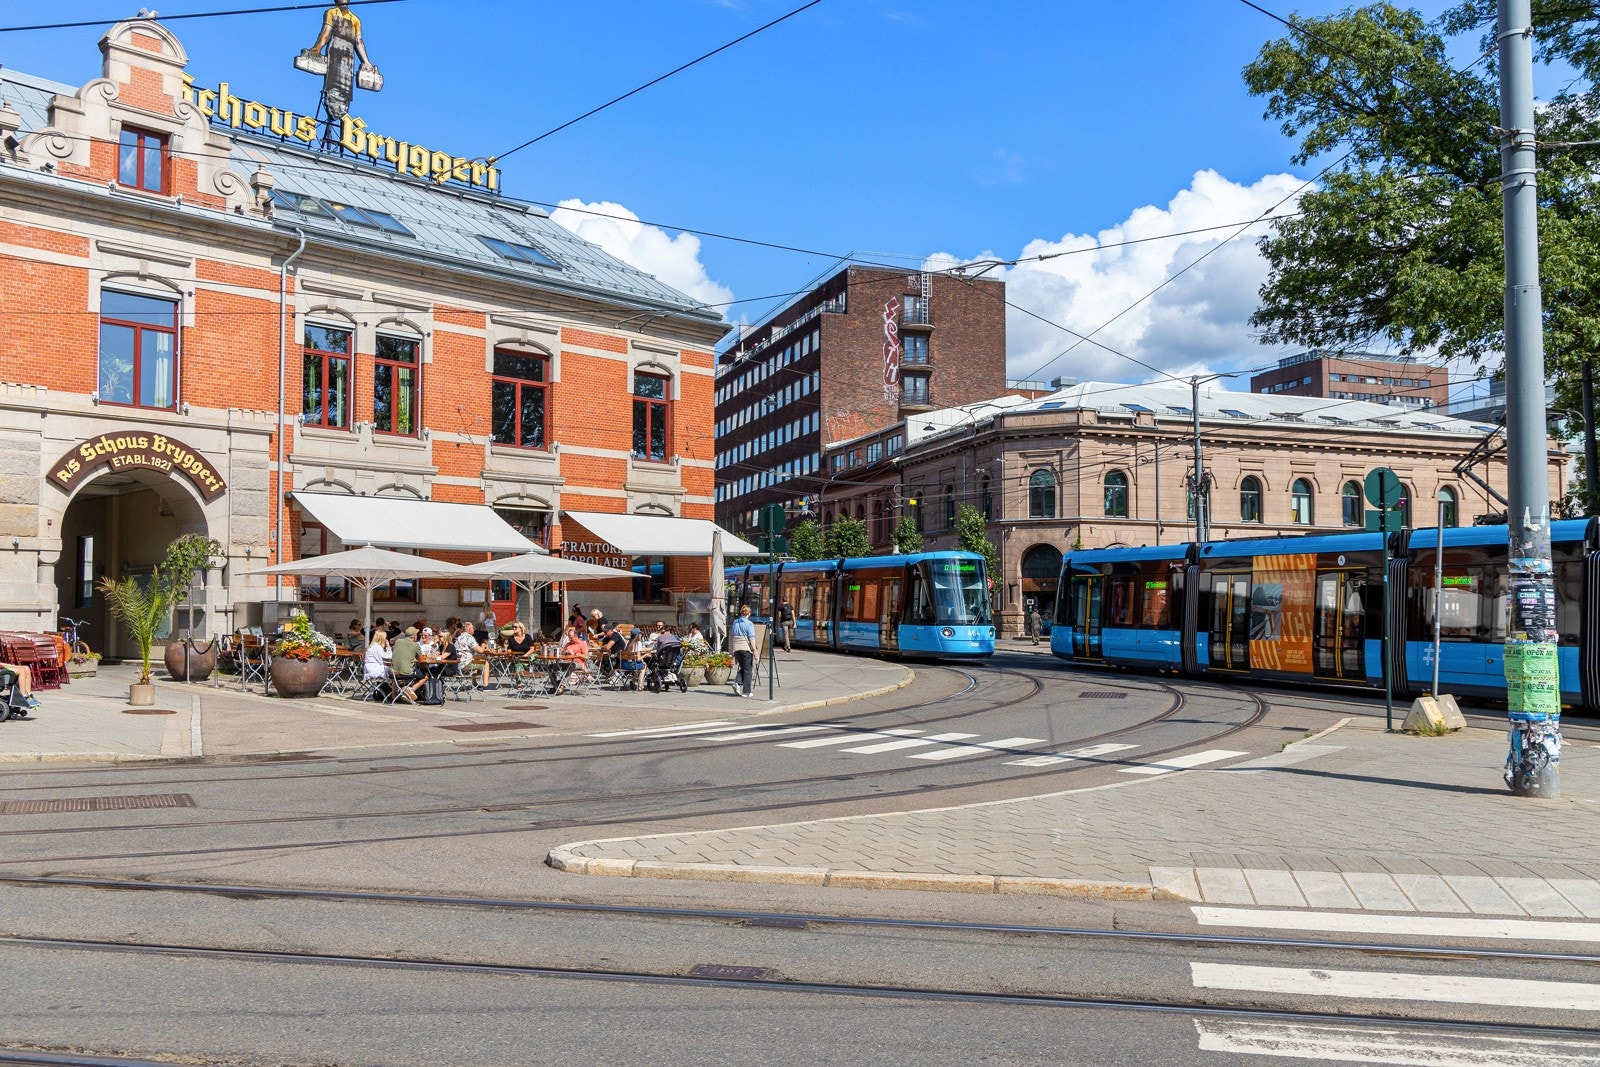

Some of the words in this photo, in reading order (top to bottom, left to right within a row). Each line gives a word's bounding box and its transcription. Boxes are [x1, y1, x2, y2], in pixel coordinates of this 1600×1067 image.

[340, 113, 497, 190] Bryggeri
[56, 458, 81, 483] A/S
[79, 435, 149, 462] Schous
[151, 434, 225, 493] Bryggeri
[562, 541, 622, 554] TRATTOR
